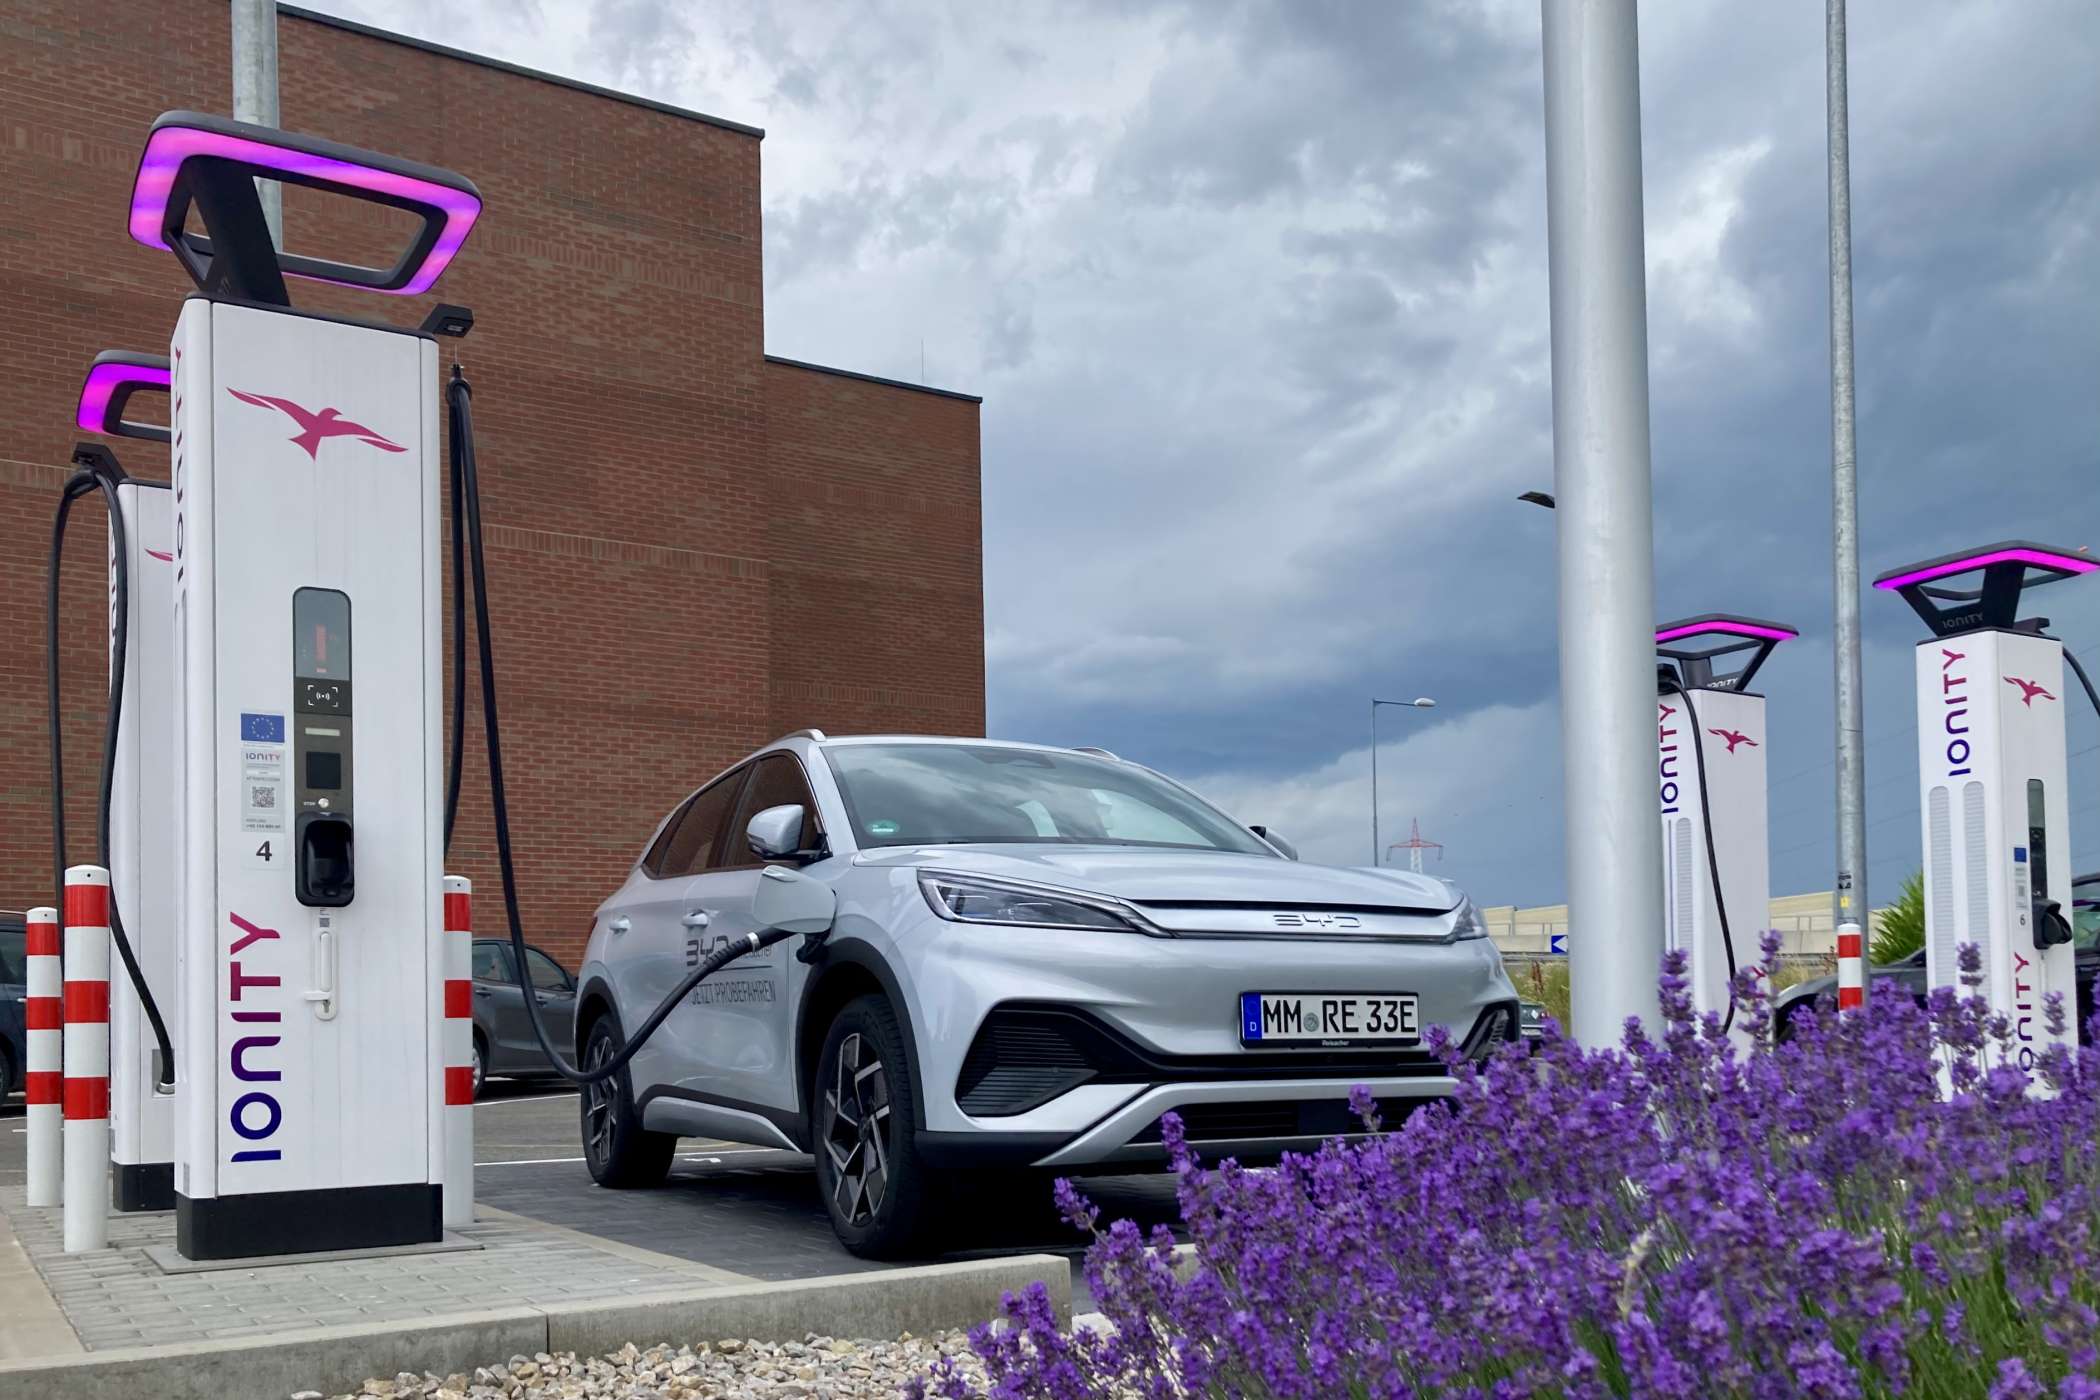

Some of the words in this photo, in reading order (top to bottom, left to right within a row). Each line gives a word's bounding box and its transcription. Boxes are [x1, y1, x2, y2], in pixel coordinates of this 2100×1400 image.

[1942, 612, 1983, 629] IONITY
[1942, 649, 1971, 777] IONITY
[246, 752, 280, 761] IONITY
[1659, 703, 1679, 814] IONITY
[256, 840, 273, 862] 4
[1273, 913, 1361, 928] BYD
[2020, 914, 2026, 926] 6
[1262, 1000, 1301, 1033] MM
[1322, 1000, 1359, 1033] RE
[1366, 1000, 1416, 1033] 33E
[230, 911, 282, 1163] IONITY
